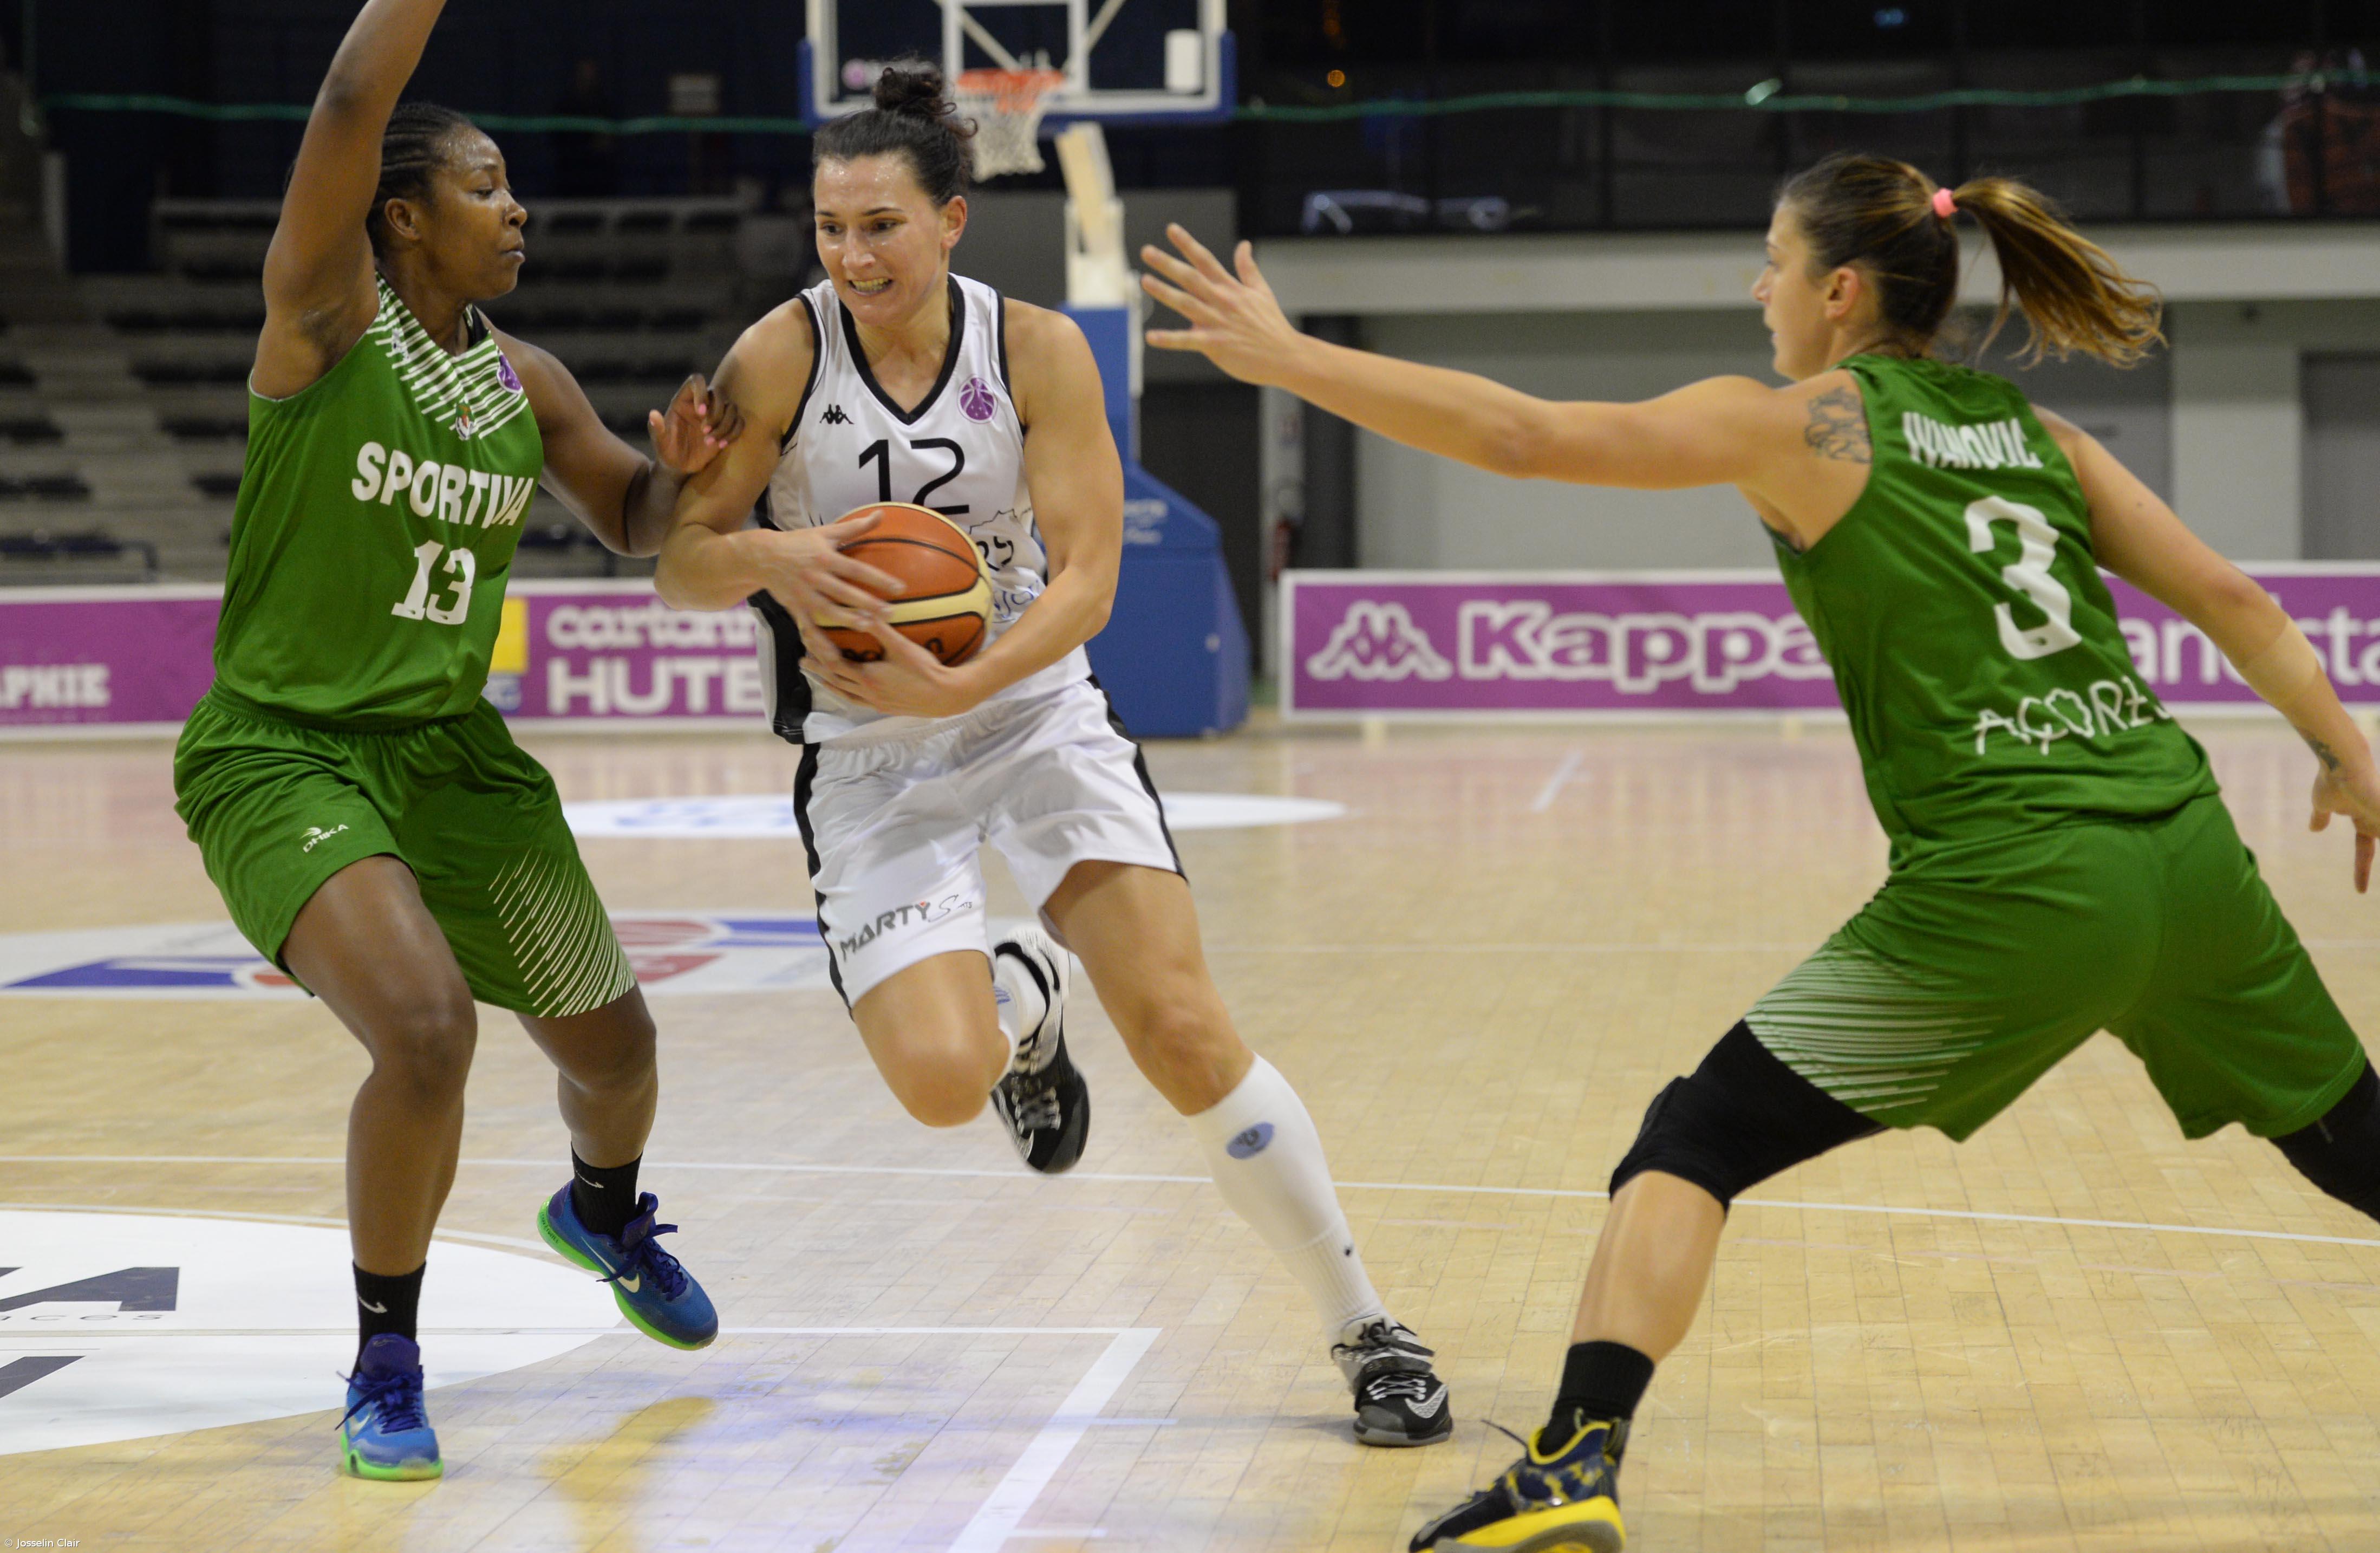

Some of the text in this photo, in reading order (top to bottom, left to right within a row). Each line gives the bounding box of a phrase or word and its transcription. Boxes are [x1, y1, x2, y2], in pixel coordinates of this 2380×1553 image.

[351, 441, 534, 529] SPORTIVA
[859, 438, 970, 515] 12
[391, 540, 475, 625] 13
[1964, 495, 2083, 660] 3
[0, 664, 110, 710] PHIE
[1457, 600, 1835, 694] Kappa
[303, 824, 349, 853] DHIKA
[840, 901, 931, 963] MARTY
